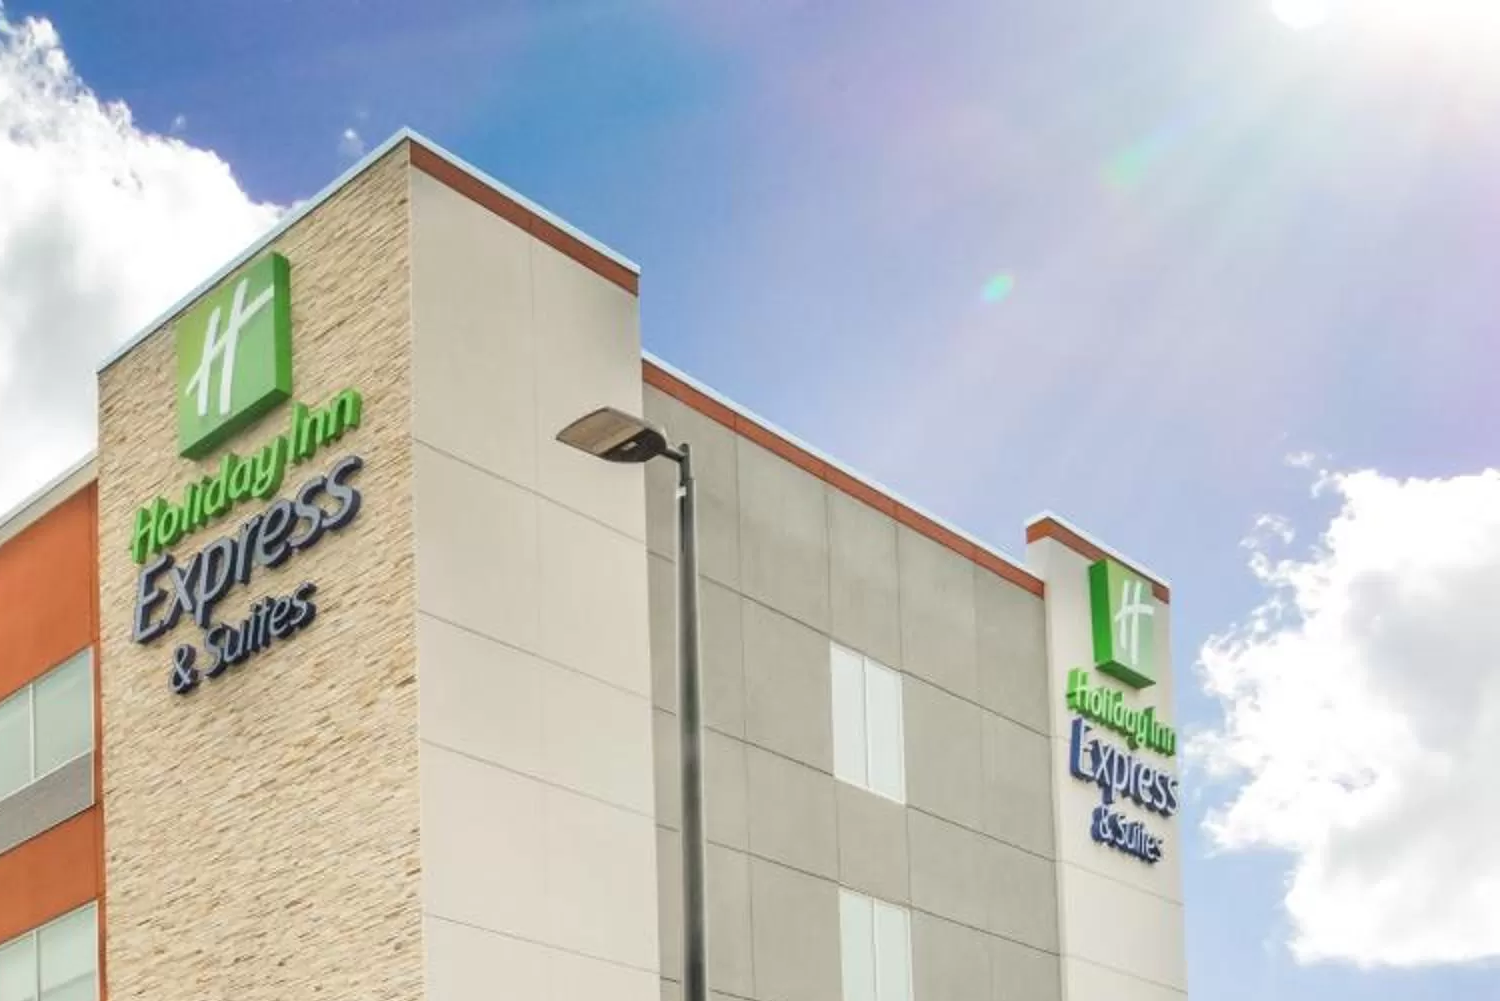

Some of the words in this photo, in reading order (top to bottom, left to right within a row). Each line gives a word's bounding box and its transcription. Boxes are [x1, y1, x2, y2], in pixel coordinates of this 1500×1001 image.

[131, 435, 287, 564] Holiday
[287, 387, 362, 464] Inn
[133, 455, 363, 644] Express
[169, 644, 198, 694] &
[204, 581, 317, 678] Suites
[1067, 668, 1148, 750] Holiday
[1151, 706, 1177, 757] Inn
[1070, 716, 1180, 819] Express
[1092, 804, 1113, 842] &
[1111, 813, 1165, 864] Suites
